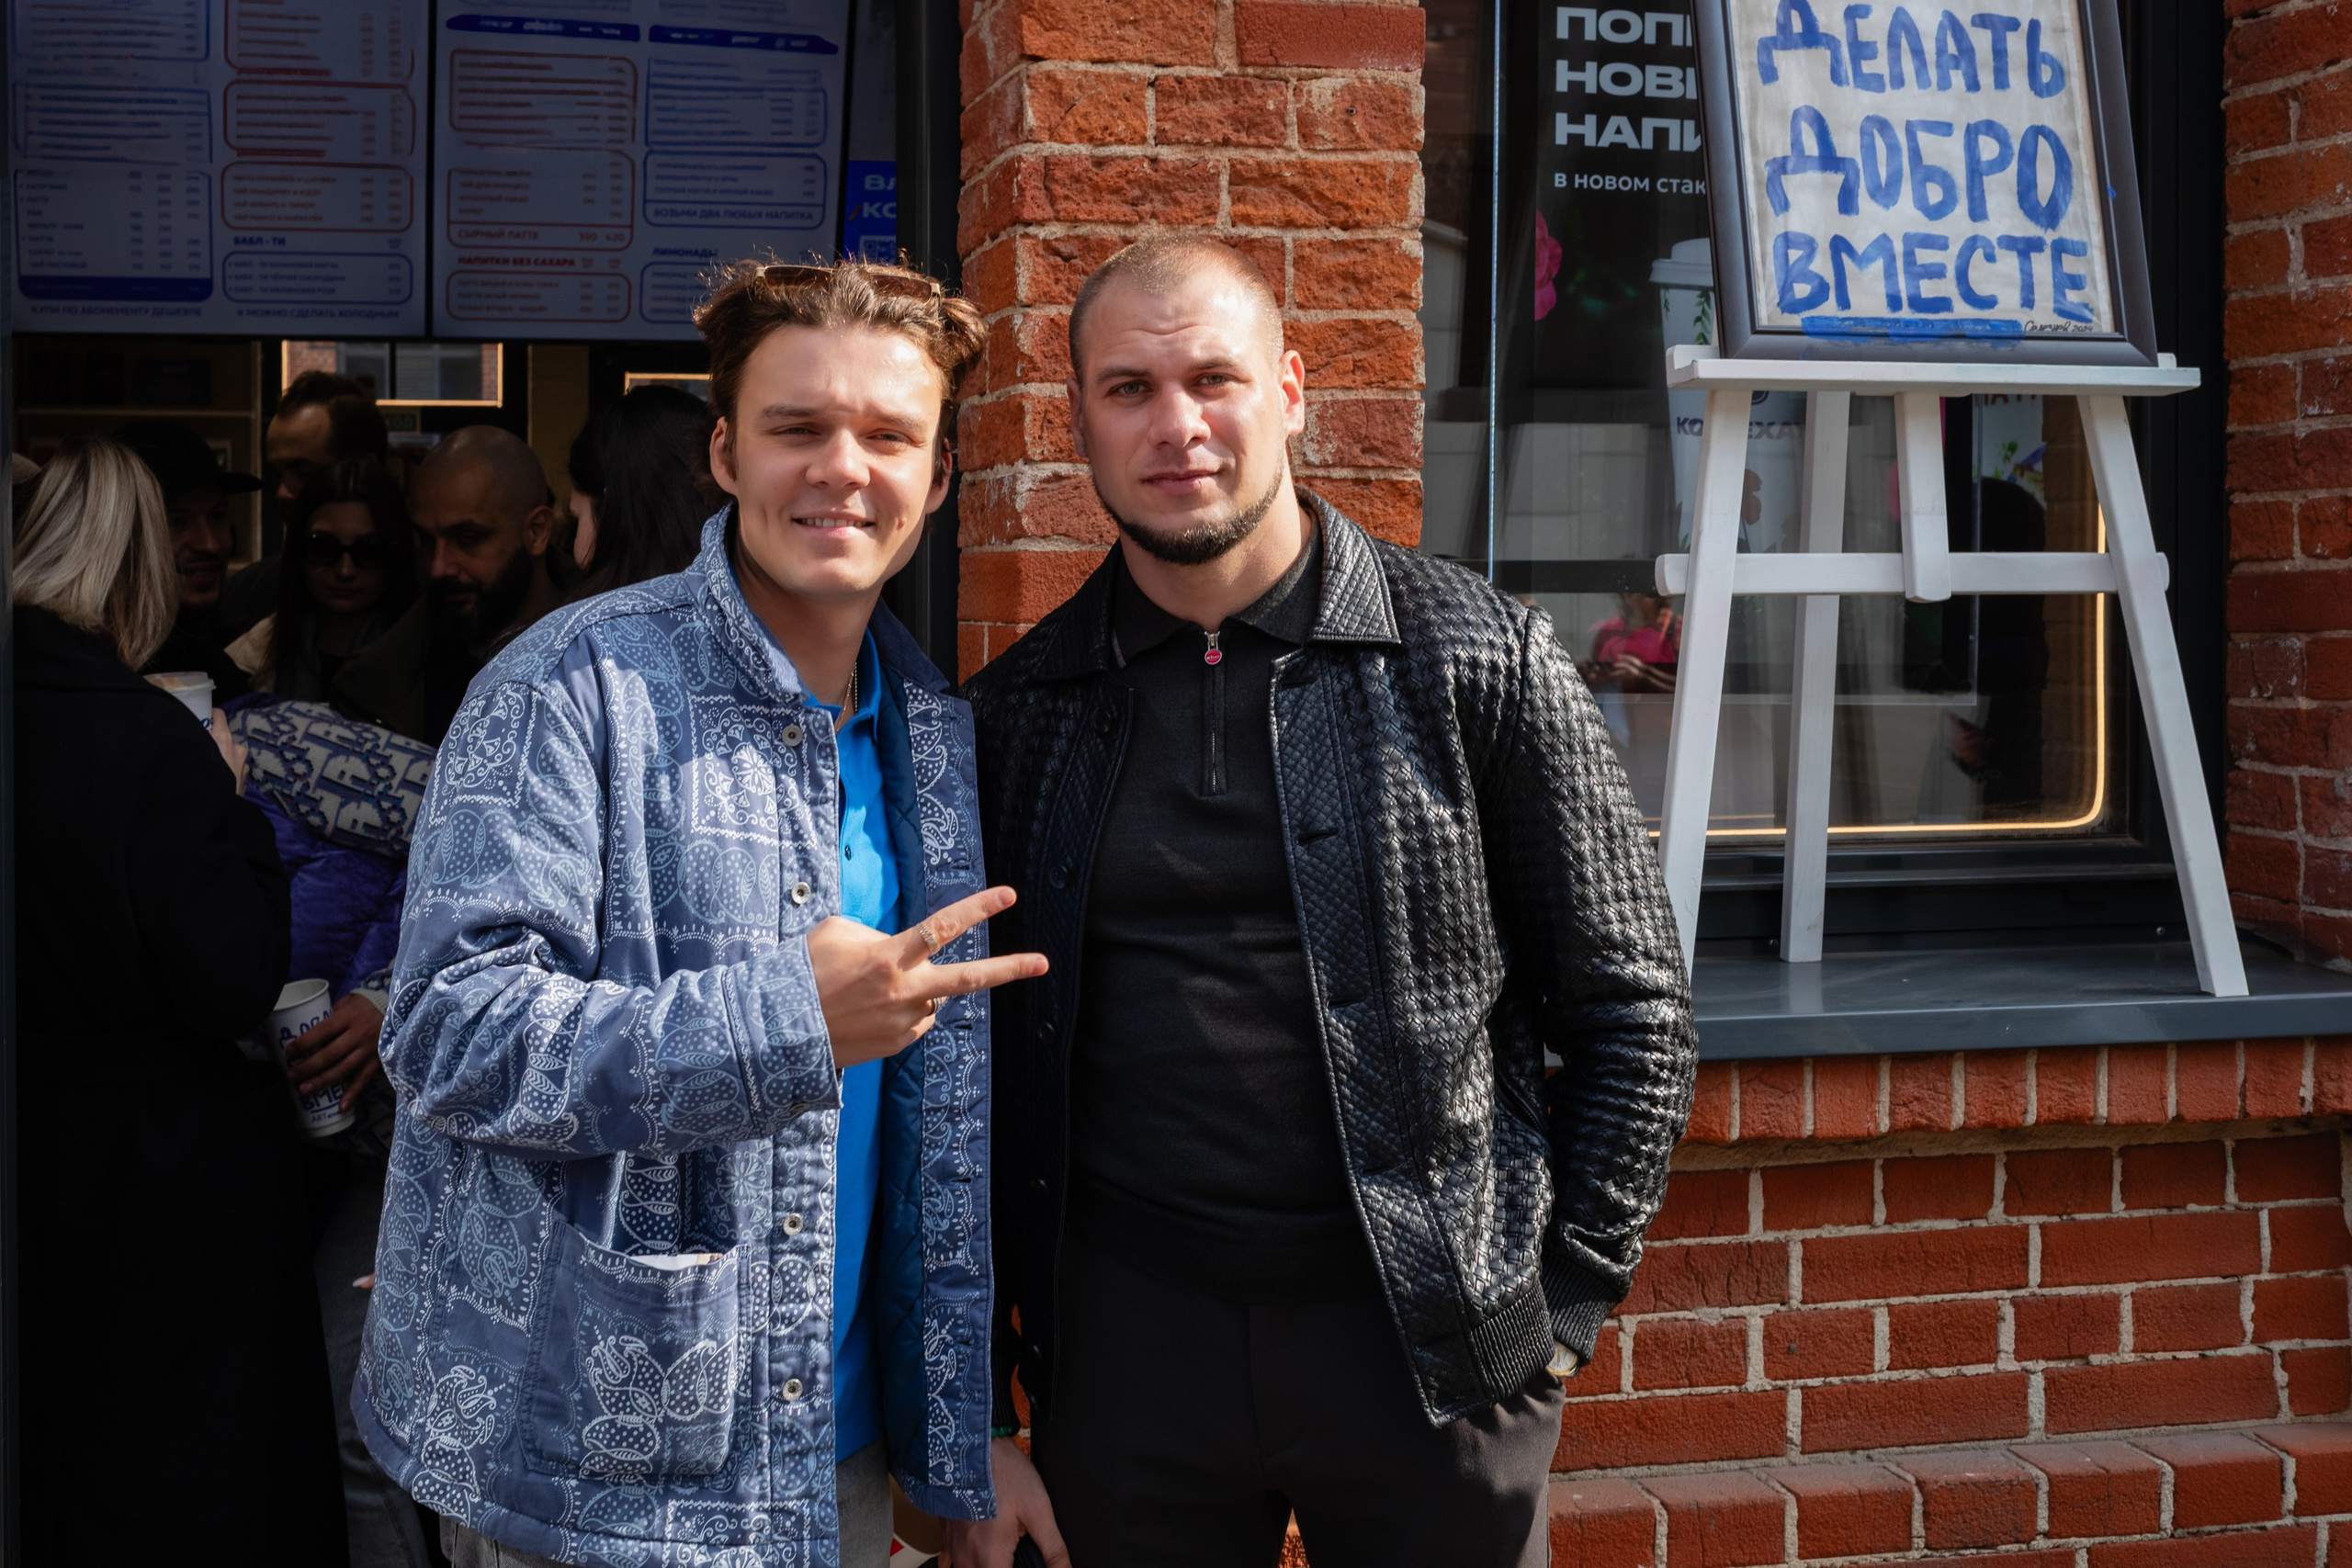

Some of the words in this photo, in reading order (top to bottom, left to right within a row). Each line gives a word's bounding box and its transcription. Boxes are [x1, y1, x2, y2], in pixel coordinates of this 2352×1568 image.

[1757, 0, 2066, 98] ДЕЛАТЬ
[1765, 105, 2074, 232] ДОБРО
[653, 208, 698, 218] ВОЗЬМИ
[699, 209, 720, 220] ДВА
[723, 209, 763, 220] ЛЮБЫХ
[765, 210, 814, 220] НАПИТКА
[233, 236, 264, 245] БАБЛ
[272, 237, 286, 245] ТИ
[507, 230, 539, 241] ЛАТТЕ
[458, 256, 510, 265] НАПИТКИ
[512, 257, 532, 266] БЕЗ
[533, 257, 576, 267] САХАРА
[1773, 231, 2095, 323] ВМЕСТЕ
[30, 305, 60, 315] КУПИ
[62, 306, 78, 315] ПО
[80, 306, 150, 316] АБОНЕМЕНТУ
[151, 307, 202, 317] ДЕШЕВЛЕ
[246, 309, 288, 318] МОЖНО
[289, 309, 335, 319] СДЕЛАТЬ
[338, 310, 400, 320] ХОЛОДНЫМ
